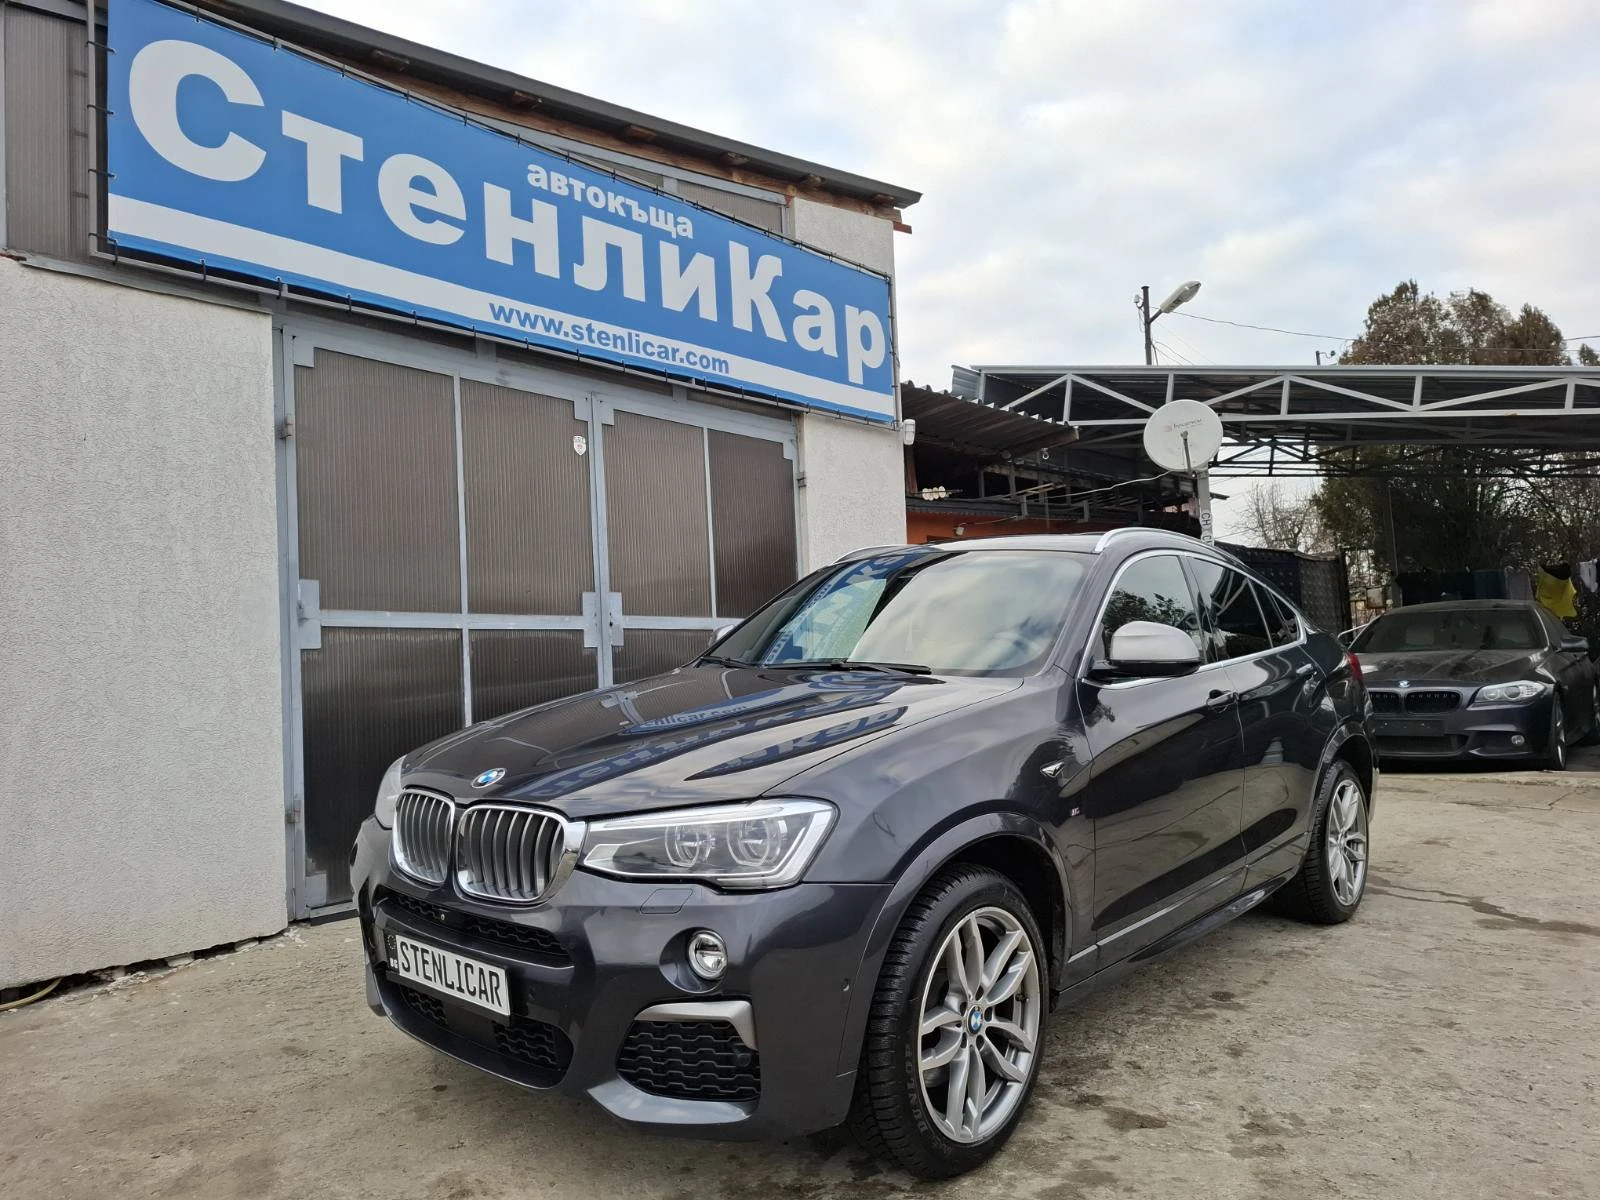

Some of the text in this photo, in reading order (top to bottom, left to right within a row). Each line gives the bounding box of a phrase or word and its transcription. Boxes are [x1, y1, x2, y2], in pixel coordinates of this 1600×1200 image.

[128, 39, 886, 385] СтенлиКар
[527, 161, 694, 241] автокъща
[488, 301, 730, 376] www.stenlicar.com
[400, 940, 502, 1008] STENLICAR
